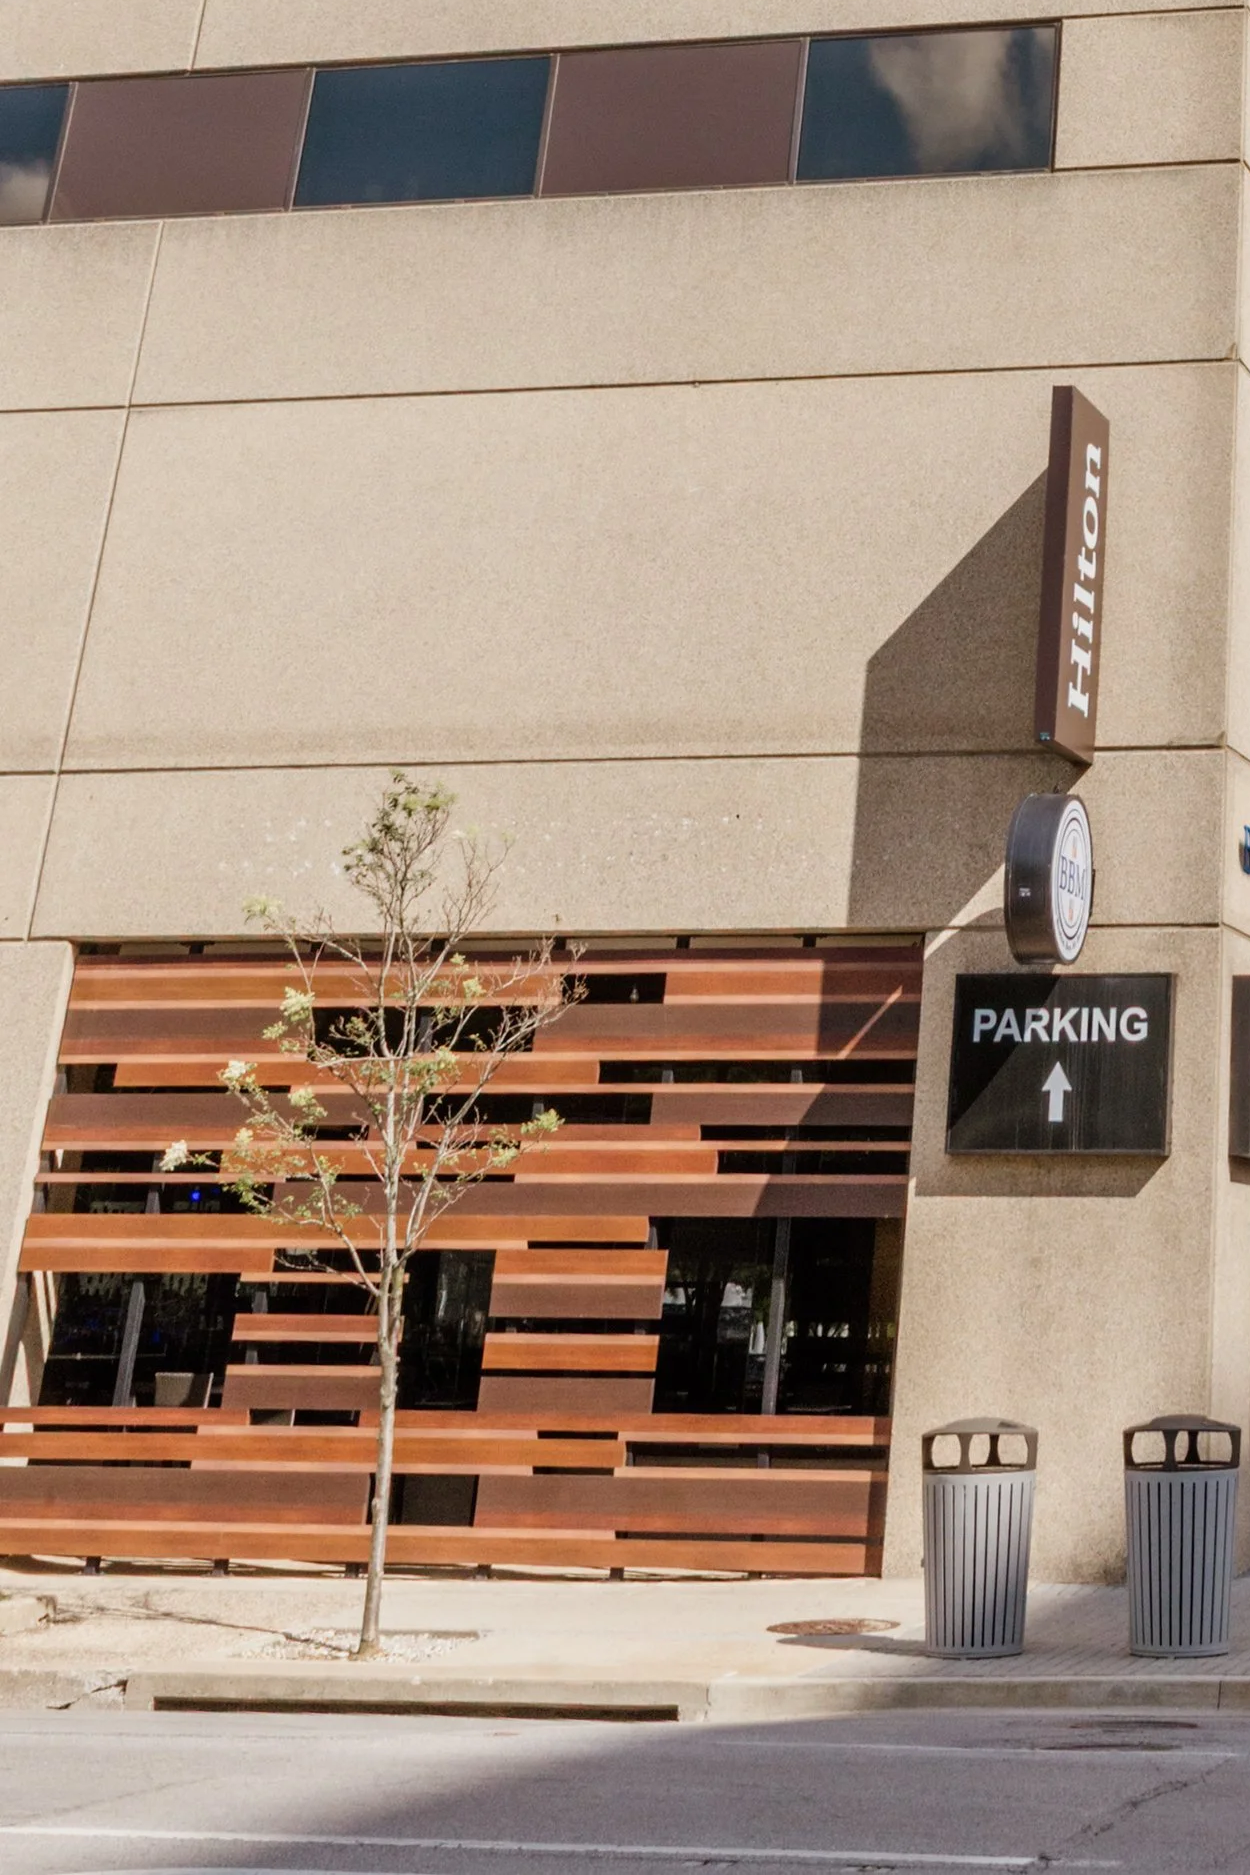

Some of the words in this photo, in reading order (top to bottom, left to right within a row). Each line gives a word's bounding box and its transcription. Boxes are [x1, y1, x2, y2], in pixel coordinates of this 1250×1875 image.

[1068, 443, 1101, 718] Hilton
[1059, 855, 1087, 901] BBM
[972, 1006, 1149, 1043] PARKING
